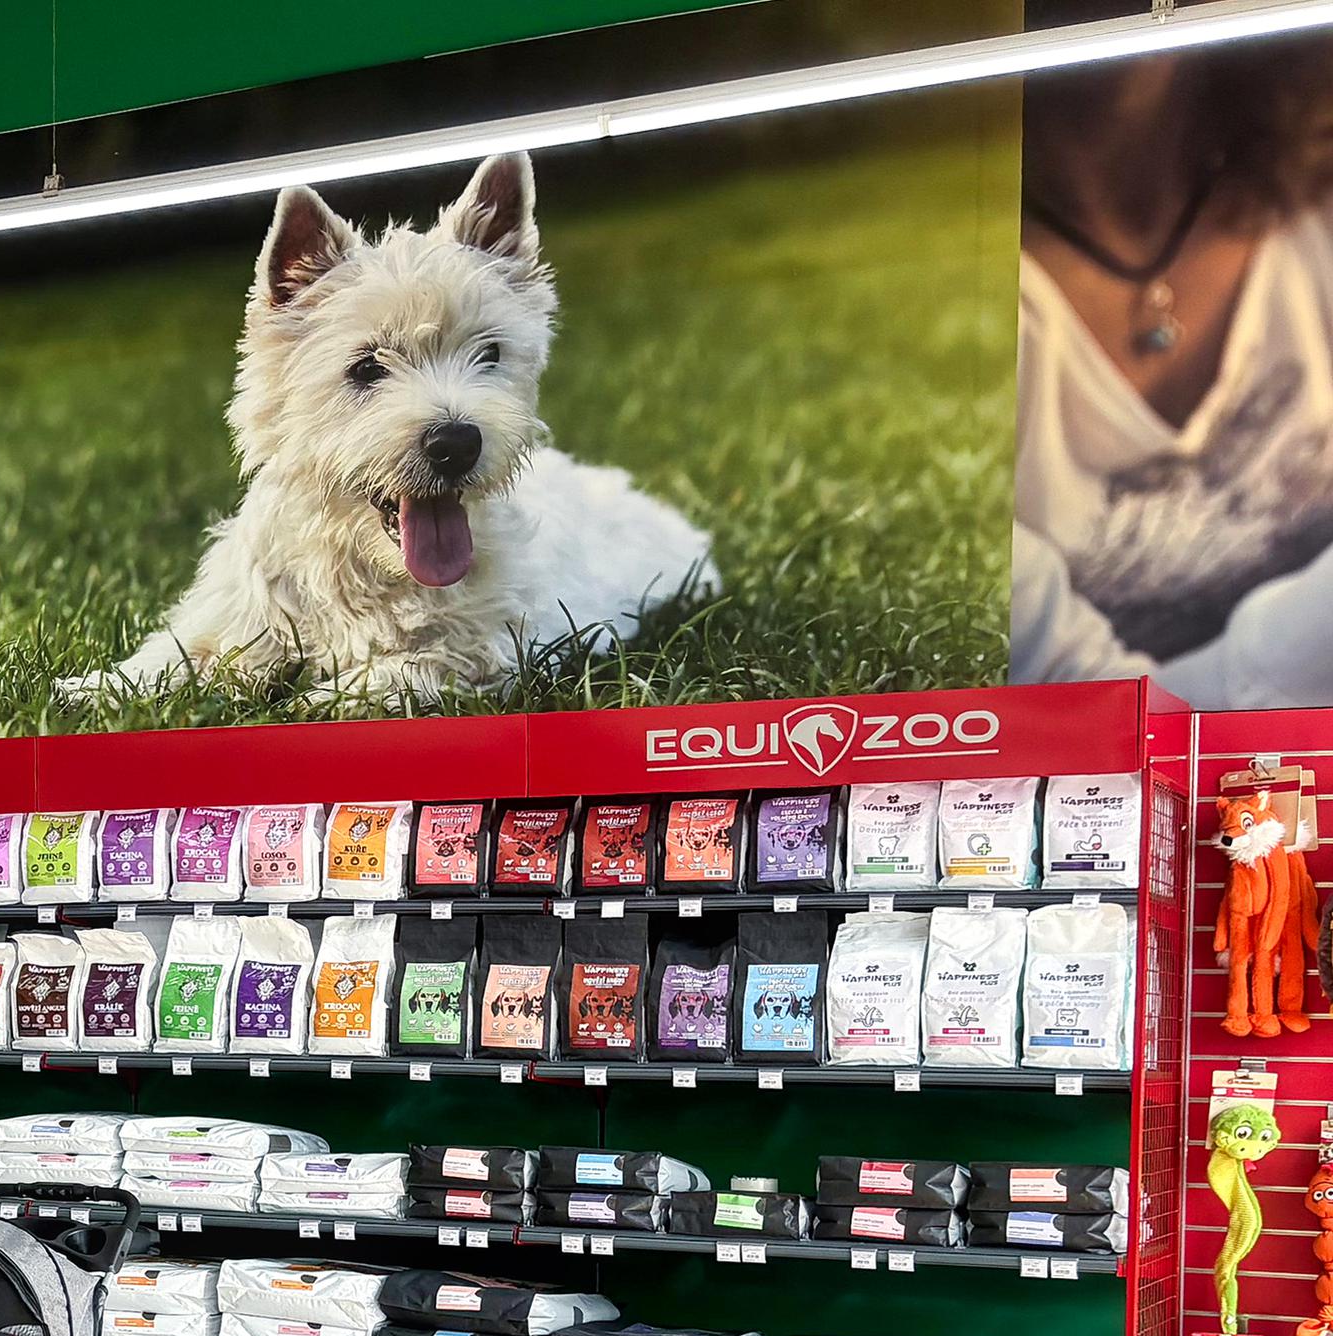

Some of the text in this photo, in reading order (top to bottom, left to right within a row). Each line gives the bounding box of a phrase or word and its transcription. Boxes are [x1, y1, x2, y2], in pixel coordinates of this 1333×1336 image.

[646, 710, 999, 761] EQUI ZOO
[261, 851, 288, 860] LOSOS
